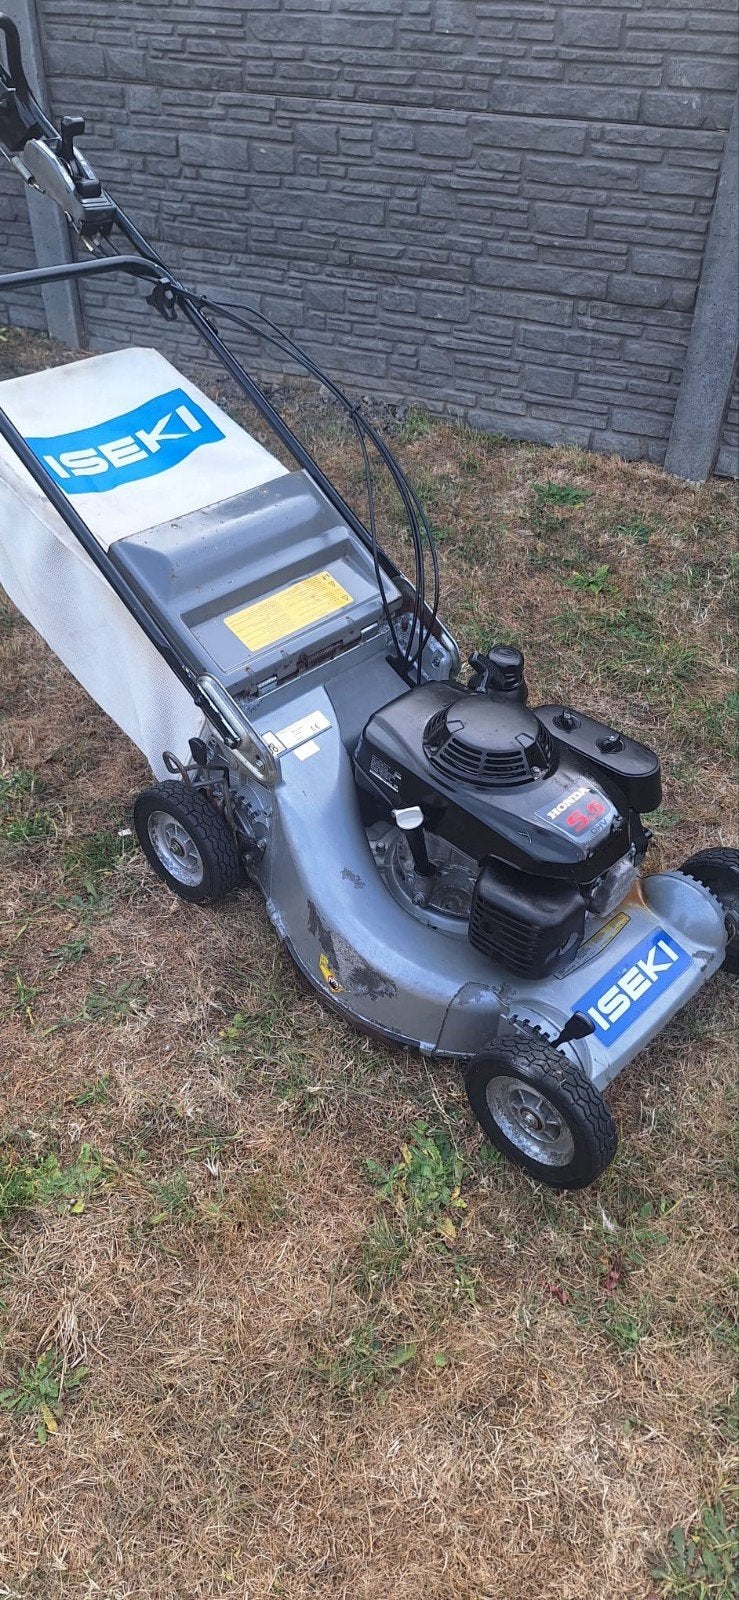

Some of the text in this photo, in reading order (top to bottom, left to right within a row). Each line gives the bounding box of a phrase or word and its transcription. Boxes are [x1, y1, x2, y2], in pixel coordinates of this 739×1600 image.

[42, 405, 202, 479] ISEKI
[546, 787, 591, 820] HONDA
[587, 939, 680, 1032] ISEKI
